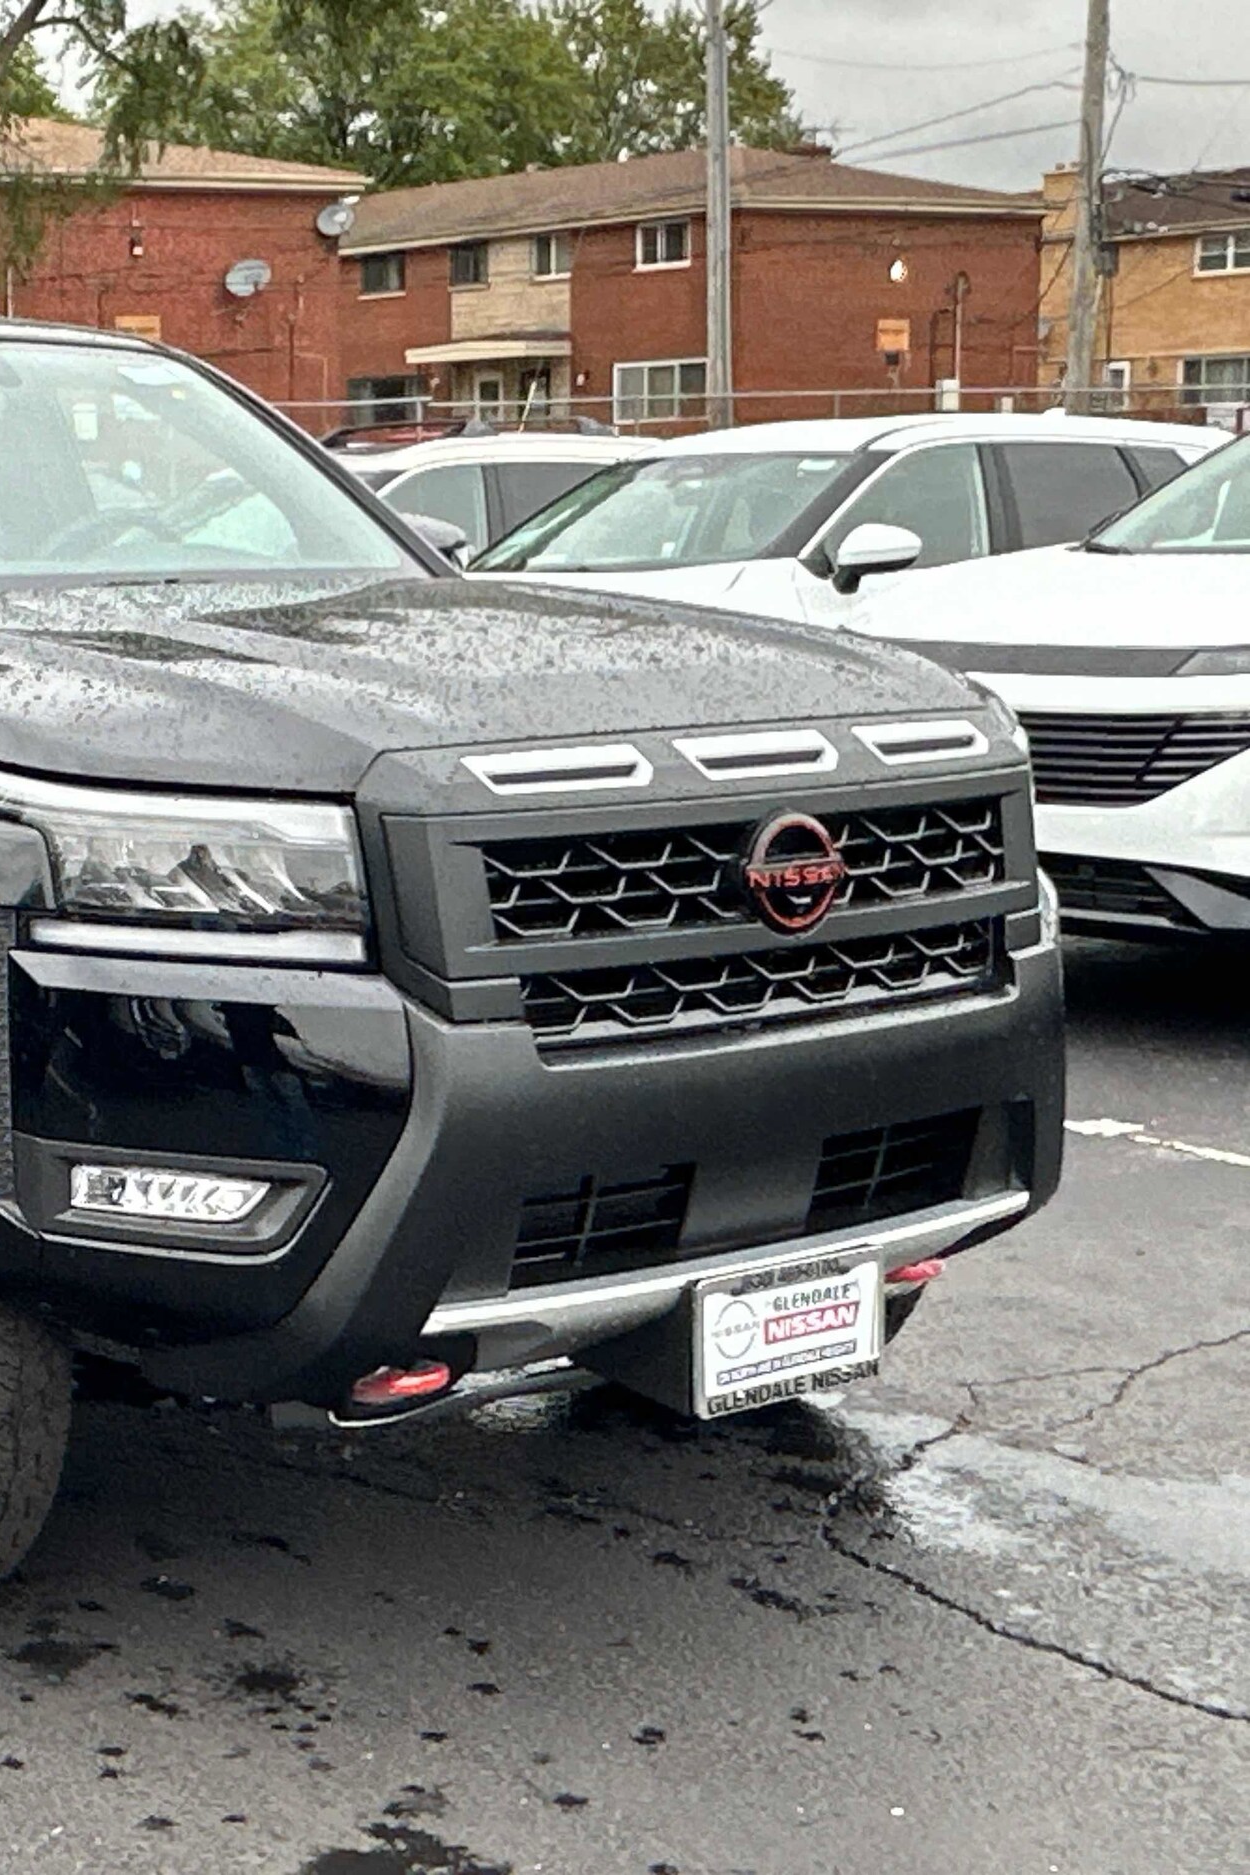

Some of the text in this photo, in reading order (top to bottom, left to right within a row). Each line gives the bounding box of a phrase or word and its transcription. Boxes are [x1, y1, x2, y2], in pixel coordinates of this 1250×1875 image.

[773, 1283, 852, 1312] GLENDALE
[766, 1304, 859, 1343] NISSAN
[707, 1376, 807, 1415] GLENDALE
[811, 1359, 880, 1391] NISSAN
